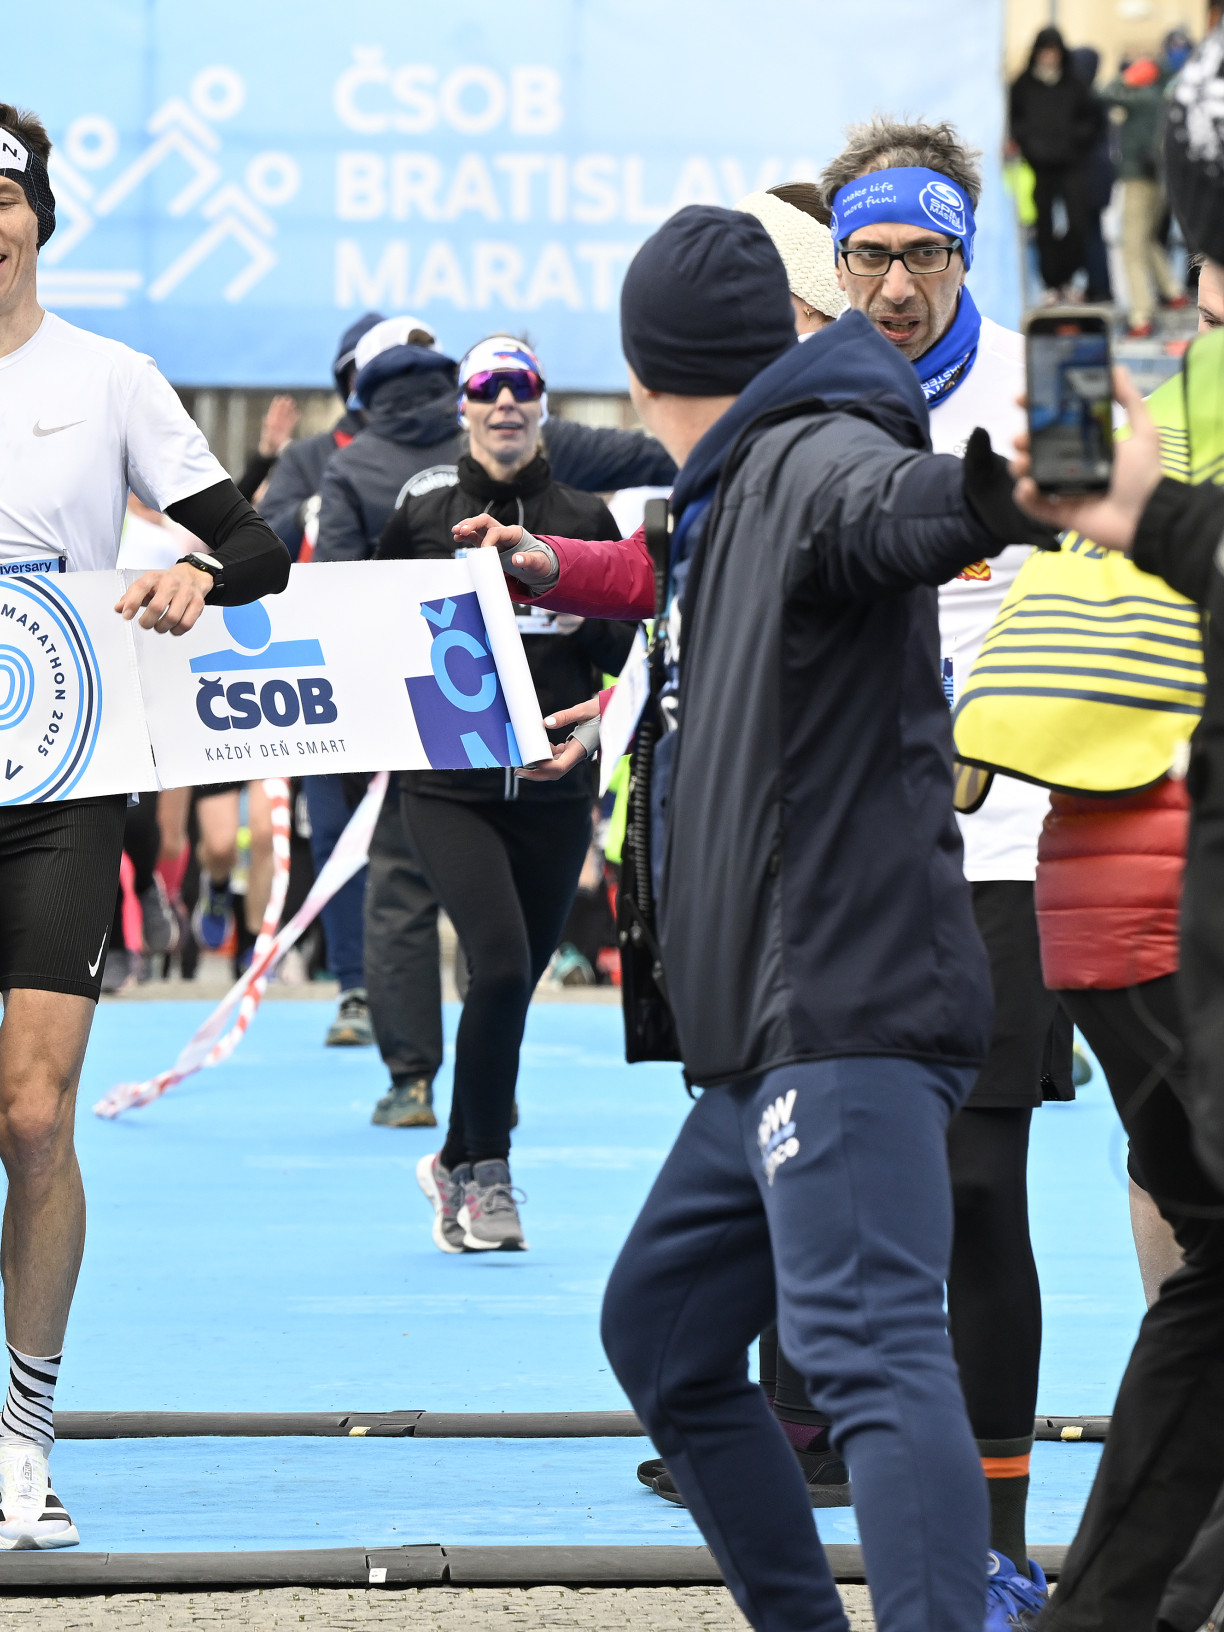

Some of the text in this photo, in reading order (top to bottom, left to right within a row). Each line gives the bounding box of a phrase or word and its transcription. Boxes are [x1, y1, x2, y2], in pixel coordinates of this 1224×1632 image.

[333, 45, 563, 135] ČSOB
[930, 198, 961, 224] SPIN
[334, 239, 626, 311] MARAT
[0, 604, 66, 700] MARATHON
[37, 710, 64, 757] 2025
[195, 676, 338, 731] ČSOB
[205, 739, 347, 761] KAŽDÝ DEŇ SMART
